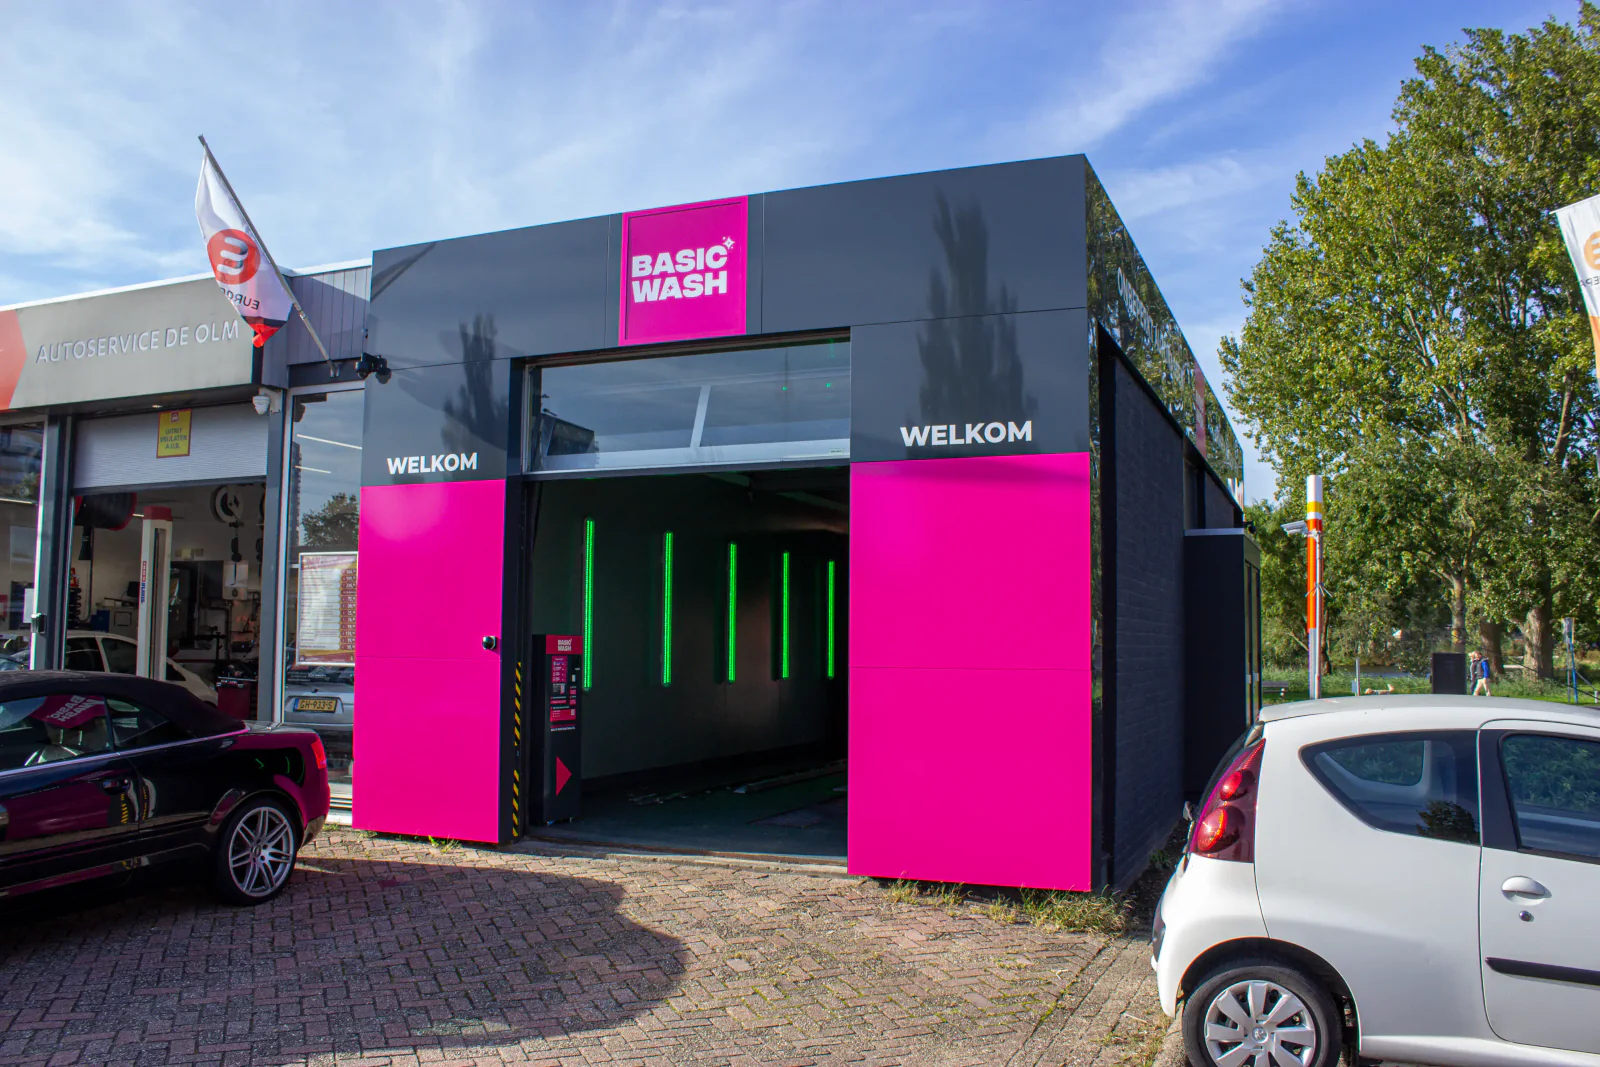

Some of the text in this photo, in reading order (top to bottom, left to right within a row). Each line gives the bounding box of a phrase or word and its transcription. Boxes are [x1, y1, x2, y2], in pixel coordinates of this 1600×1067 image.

[631, 245, 728, 278] BASIC
[631, 271, 728, 303] WASH
[36, 319, 239, 364] AUTOSERVICE DE OLM
[900, 420, 1032, 447] WELKOM
[386, 452, 478, 475] WELKOM
[300, 700, 333, 710] GH-933-S
